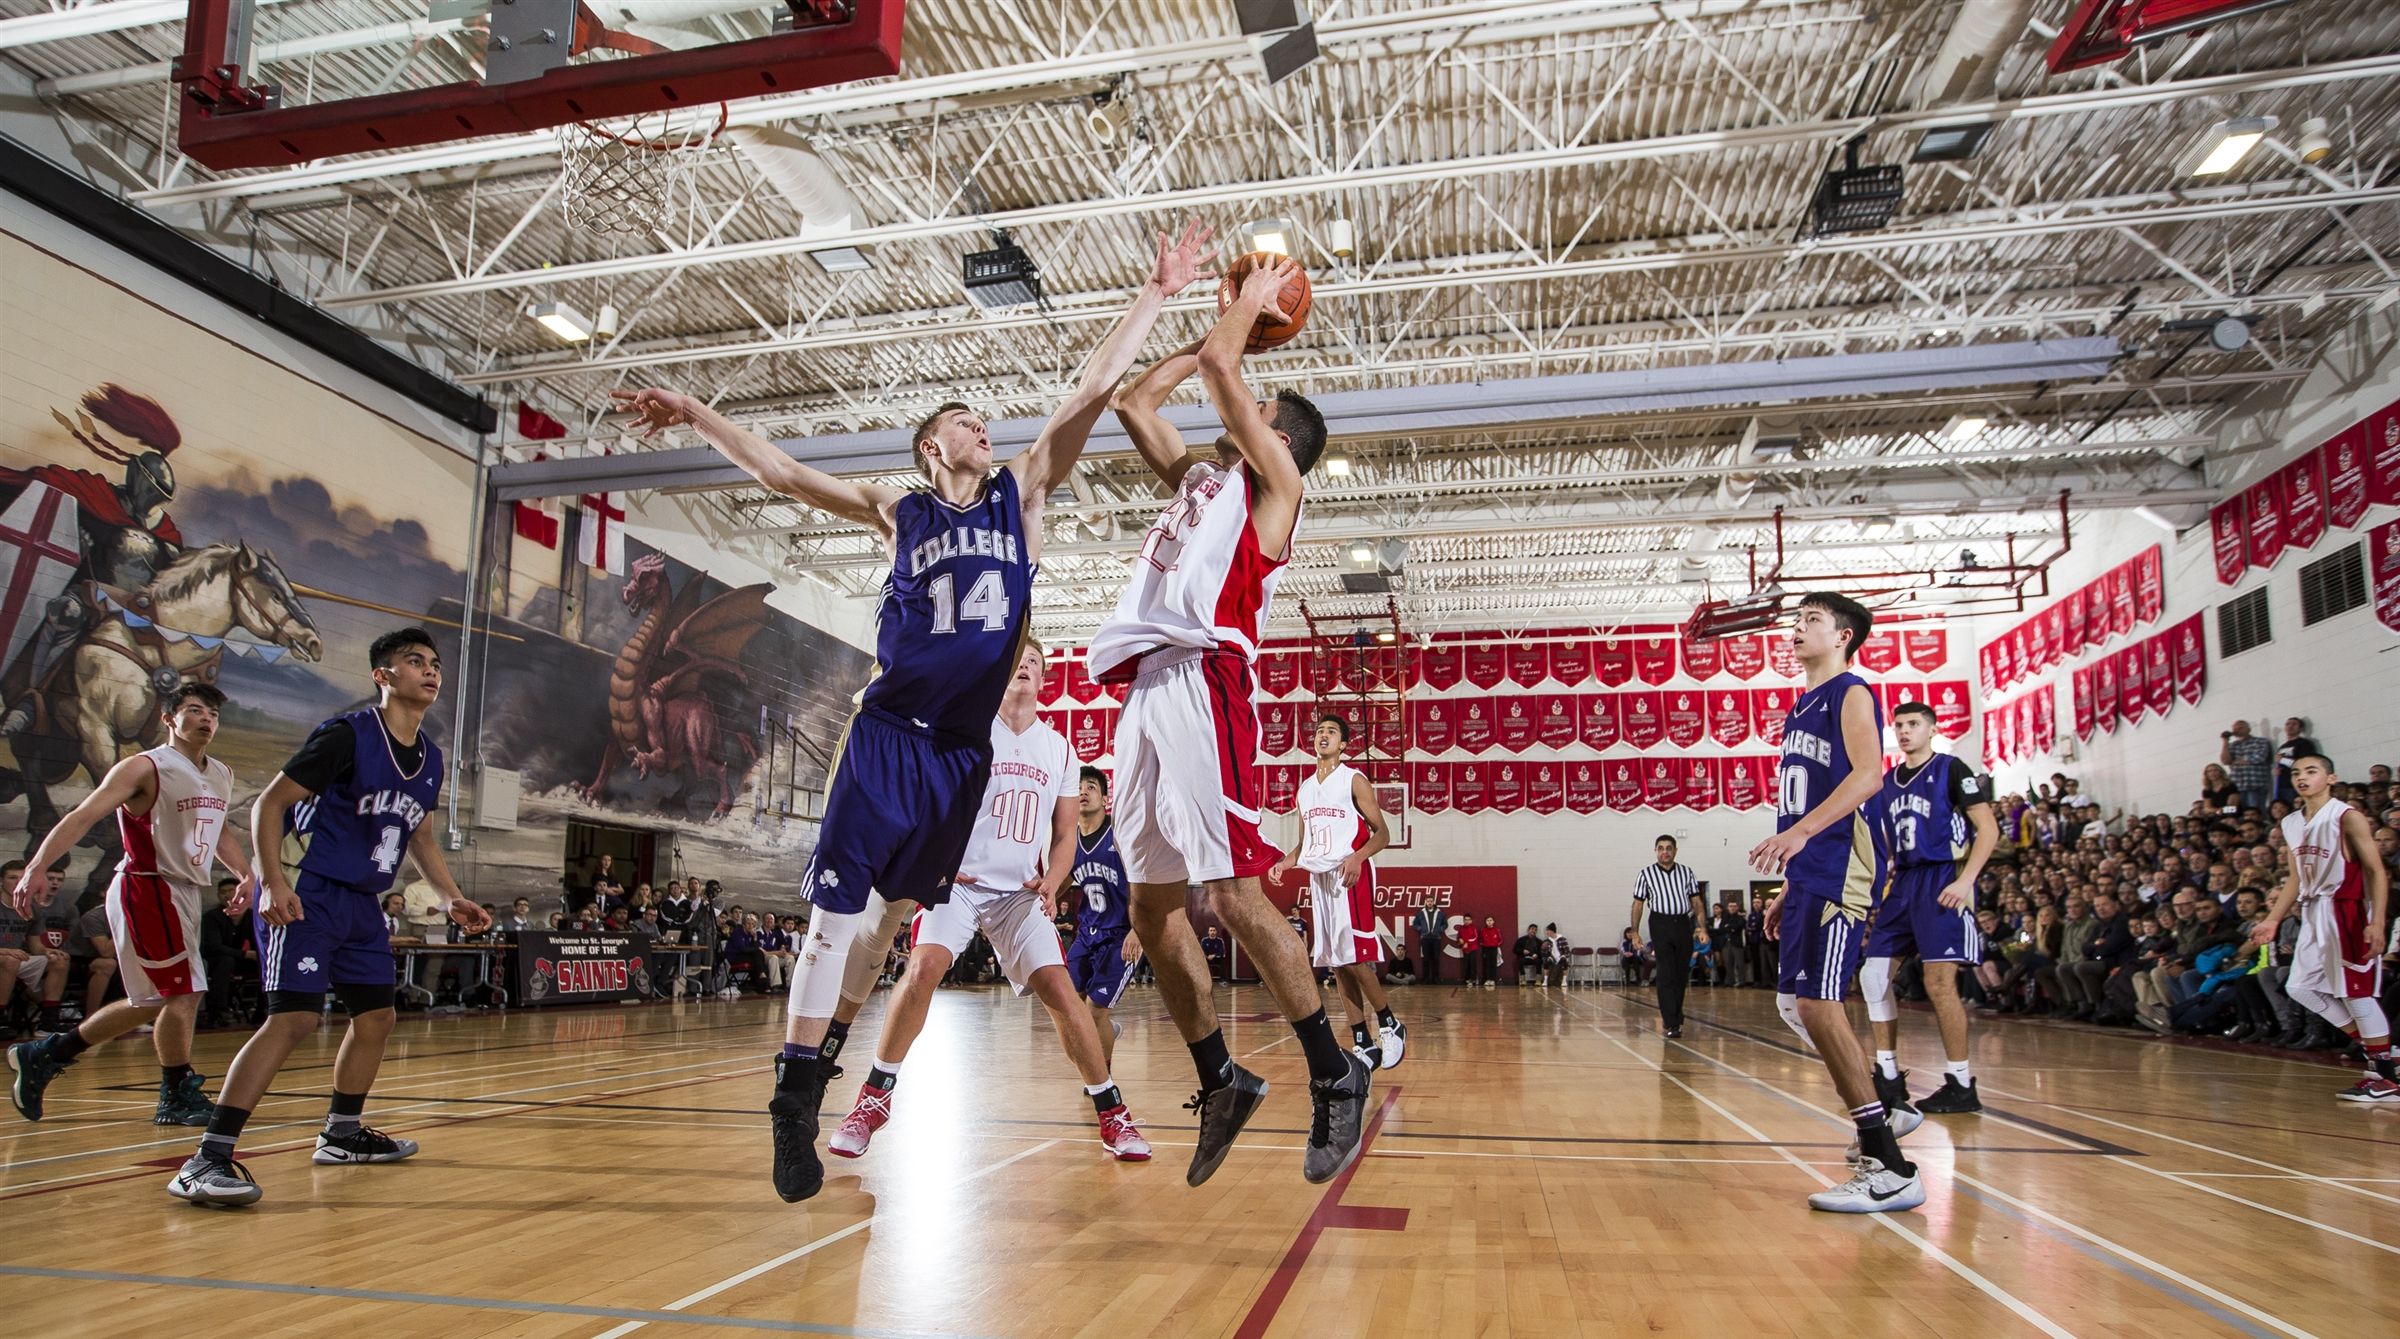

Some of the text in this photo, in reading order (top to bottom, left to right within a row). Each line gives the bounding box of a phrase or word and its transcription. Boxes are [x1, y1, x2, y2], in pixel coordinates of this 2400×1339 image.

[910, 526, 1018, 577] COLLEGE
[928, 570, 1009, 634] 14
[990, 762, 1050, 787] T.GEORGE'S
[992, 789, 1039, 843] 40
[191, 817, 214, 867] 5
[370, 825, 401, 874] 4
[1374, 885, 1453, 908] OF THE
[548, 937, 580, 945] Welcome
[601, 937, 630, 946] George's
[561, 945, 618, 955] HOME OF THE
[557, 959, 628, 993] SAINTS
